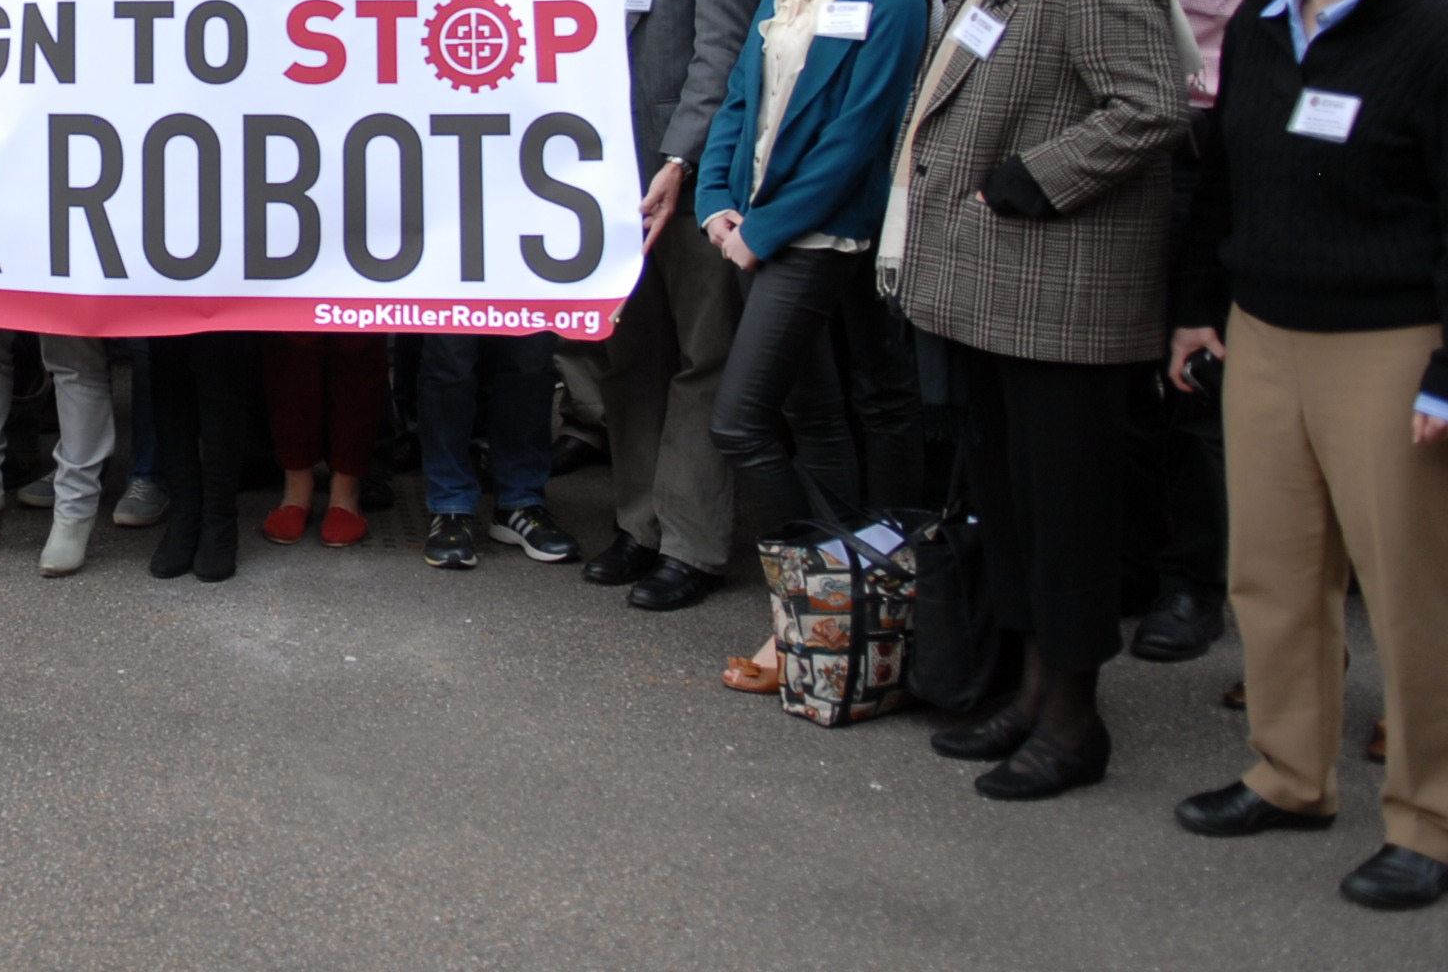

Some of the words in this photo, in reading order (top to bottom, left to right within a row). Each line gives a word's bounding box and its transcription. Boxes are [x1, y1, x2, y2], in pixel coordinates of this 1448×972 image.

[113, 0, 249, 86] TO
[47, 111, 605, 285] ROBOTS
[314, 303, 601, 335] StopKillerRobots.org
